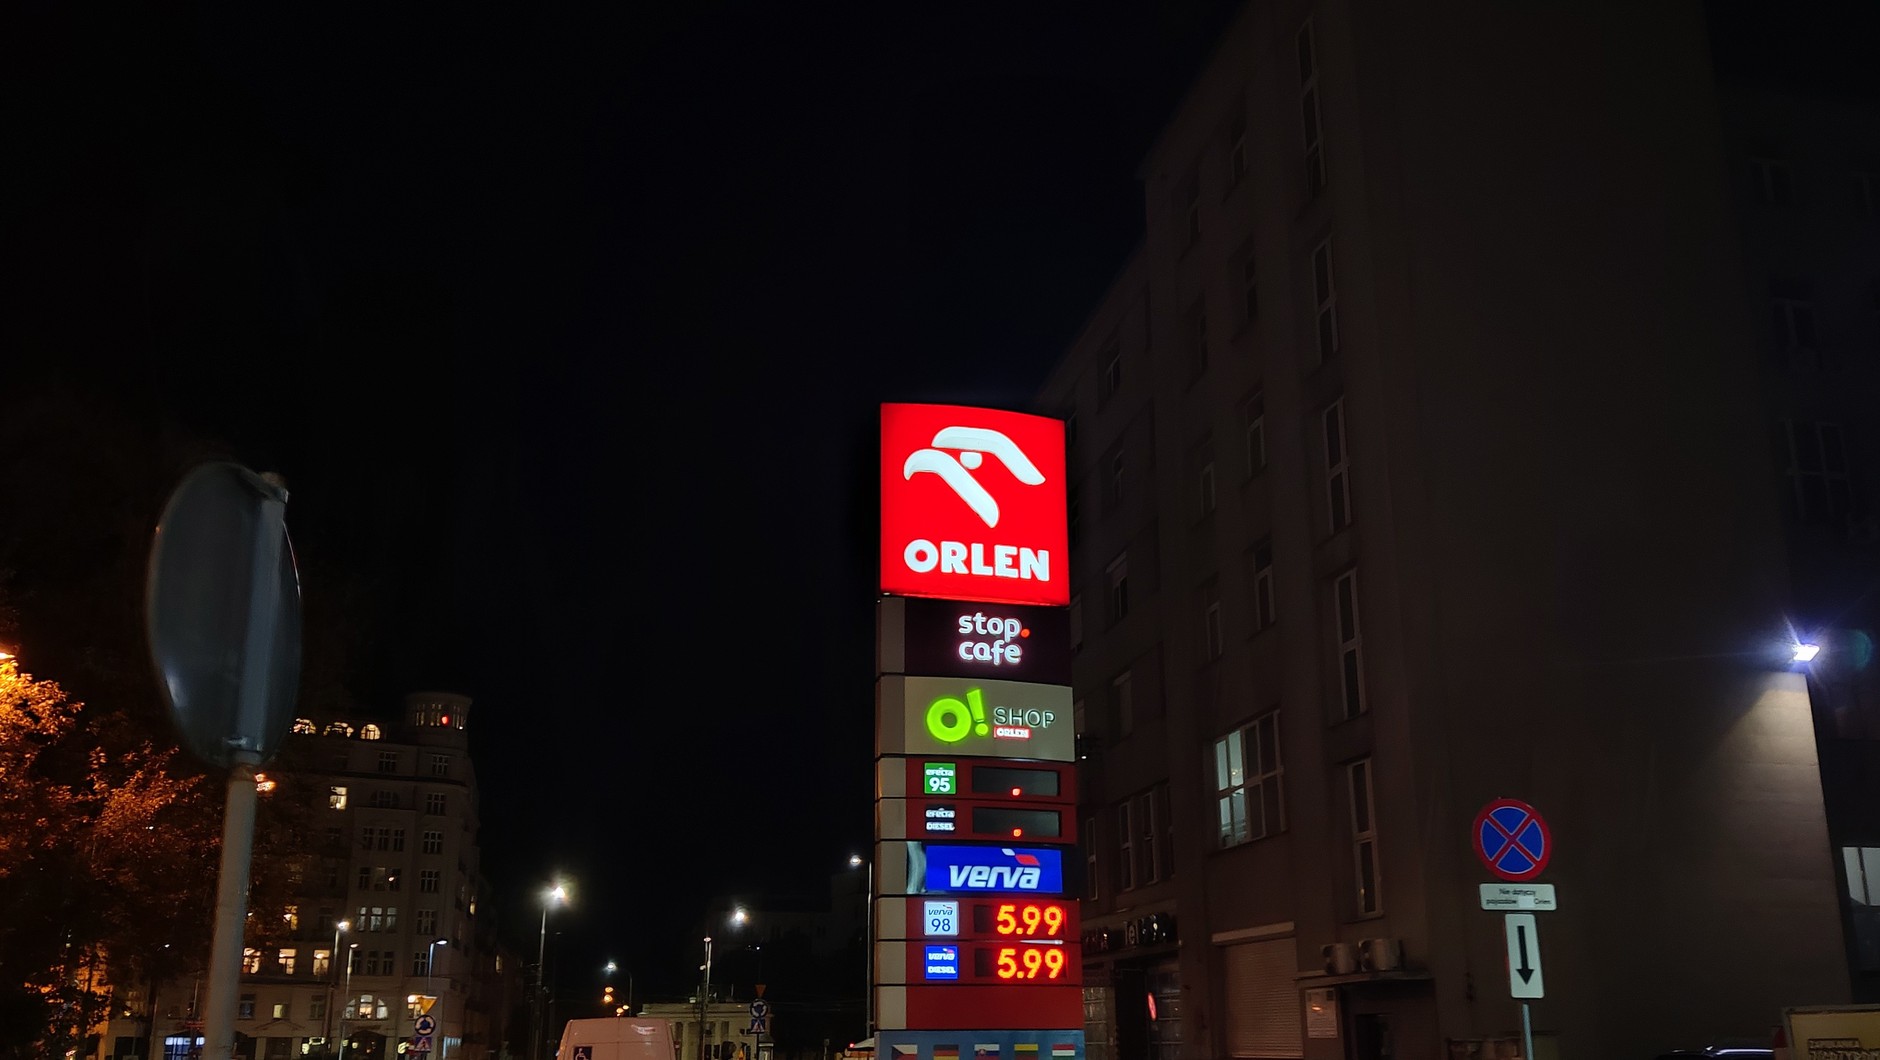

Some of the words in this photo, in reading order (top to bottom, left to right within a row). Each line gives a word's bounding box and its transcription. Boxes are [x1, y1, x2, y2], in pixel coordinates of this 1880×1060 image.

[904, 539, 1050, 581] ORLEN
[958, 640, 1022, 665] cafe
[994, 706, 1056, 728] SHOP
[929, 777, 951, 792] 95
[926, 822, 955, 831] DIESEL
[949, 864, 1041, 889] verva
[931, 918, 951, 932] 98
[997, 905, 1062, 935] 5.99
[998, 948, 1064, 979] 5.99
